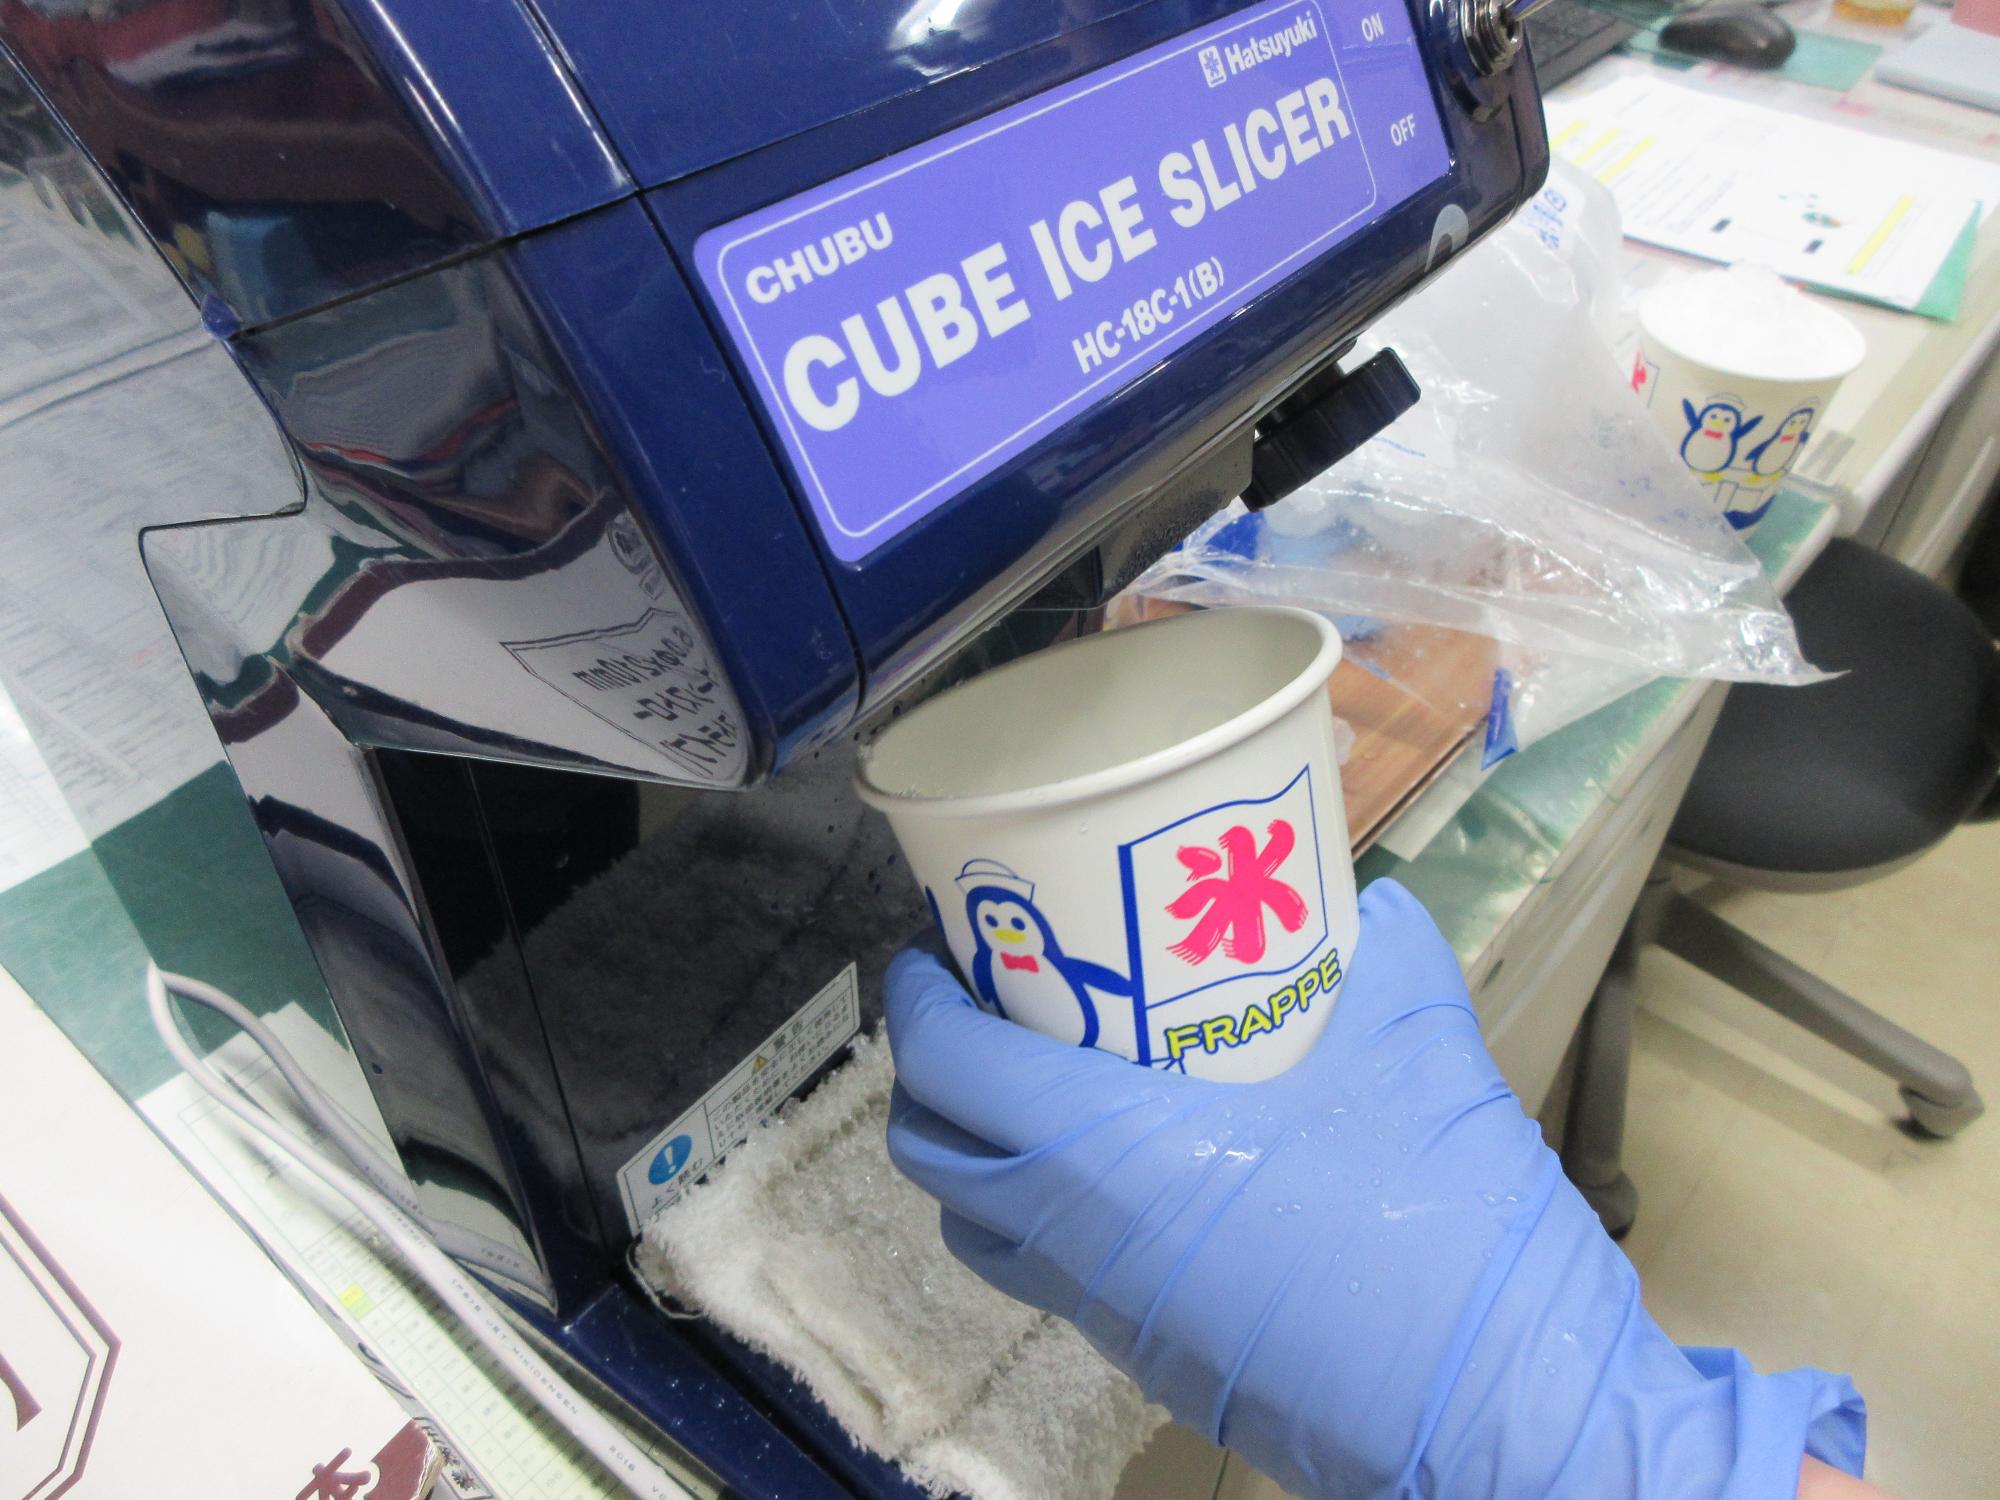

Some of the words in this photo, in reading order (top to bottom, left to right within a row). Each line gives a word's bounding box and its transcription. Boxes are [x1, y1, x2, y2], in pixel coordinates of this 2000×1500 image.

[1224, 11, 1318, 76] Hatsuyuki
[1361, 13, 1385, 43] ON
[1390, 113, 1417, 147] OFF
[746, 212, 894, 305] CHUBU
[783, 242, 1030, 432] CUBE
[1030, 175, 1157, 299] ICE
[1159, 76, 1352, 229] SLICER
[1072, 255, 1225, 375] HC-18C-1(B)
[1164, 818, 1309, 967] 氷
[1164, 947, 1343, 1061] FRAPPE
